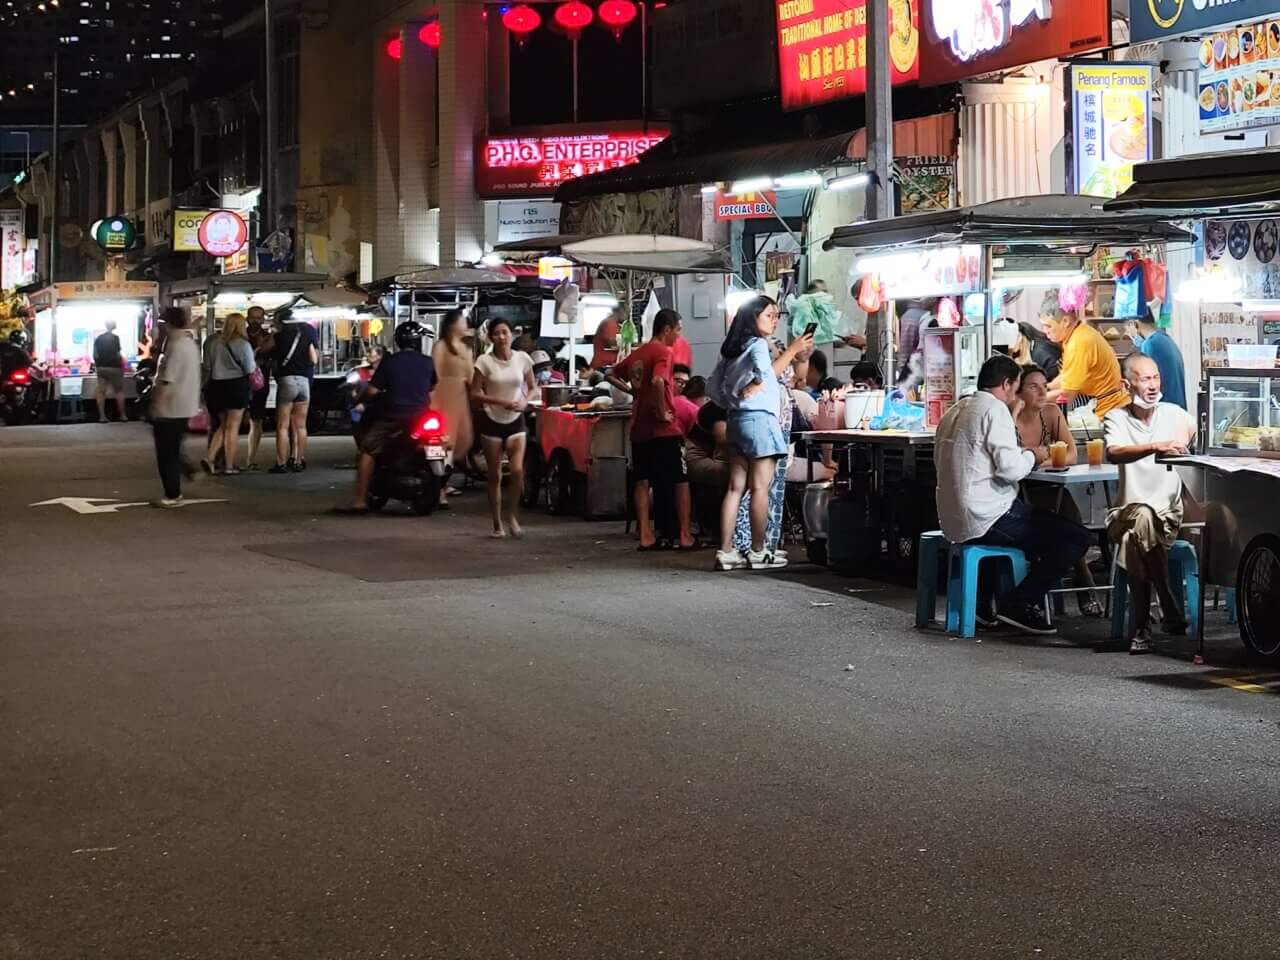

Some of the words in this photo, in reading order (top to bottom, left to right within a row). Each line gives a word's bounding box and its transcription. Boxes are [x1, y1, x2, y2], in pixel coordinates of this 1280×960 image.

[781, 18, 823, 46] TRADITIONAL
[824, 12, 844, 35] HOME
[844, 9, 854, 29] OF
[1078, 72, 1110, 89] Penang
[1111, 72, 1146, 87] Famous
[487, 145, 538, 161] P.H.G.
[906, 155, 948, 165] FRIED
[902, 165, 953, 177] OYSTER
[719, 203, 753, 216] SPECIAL
